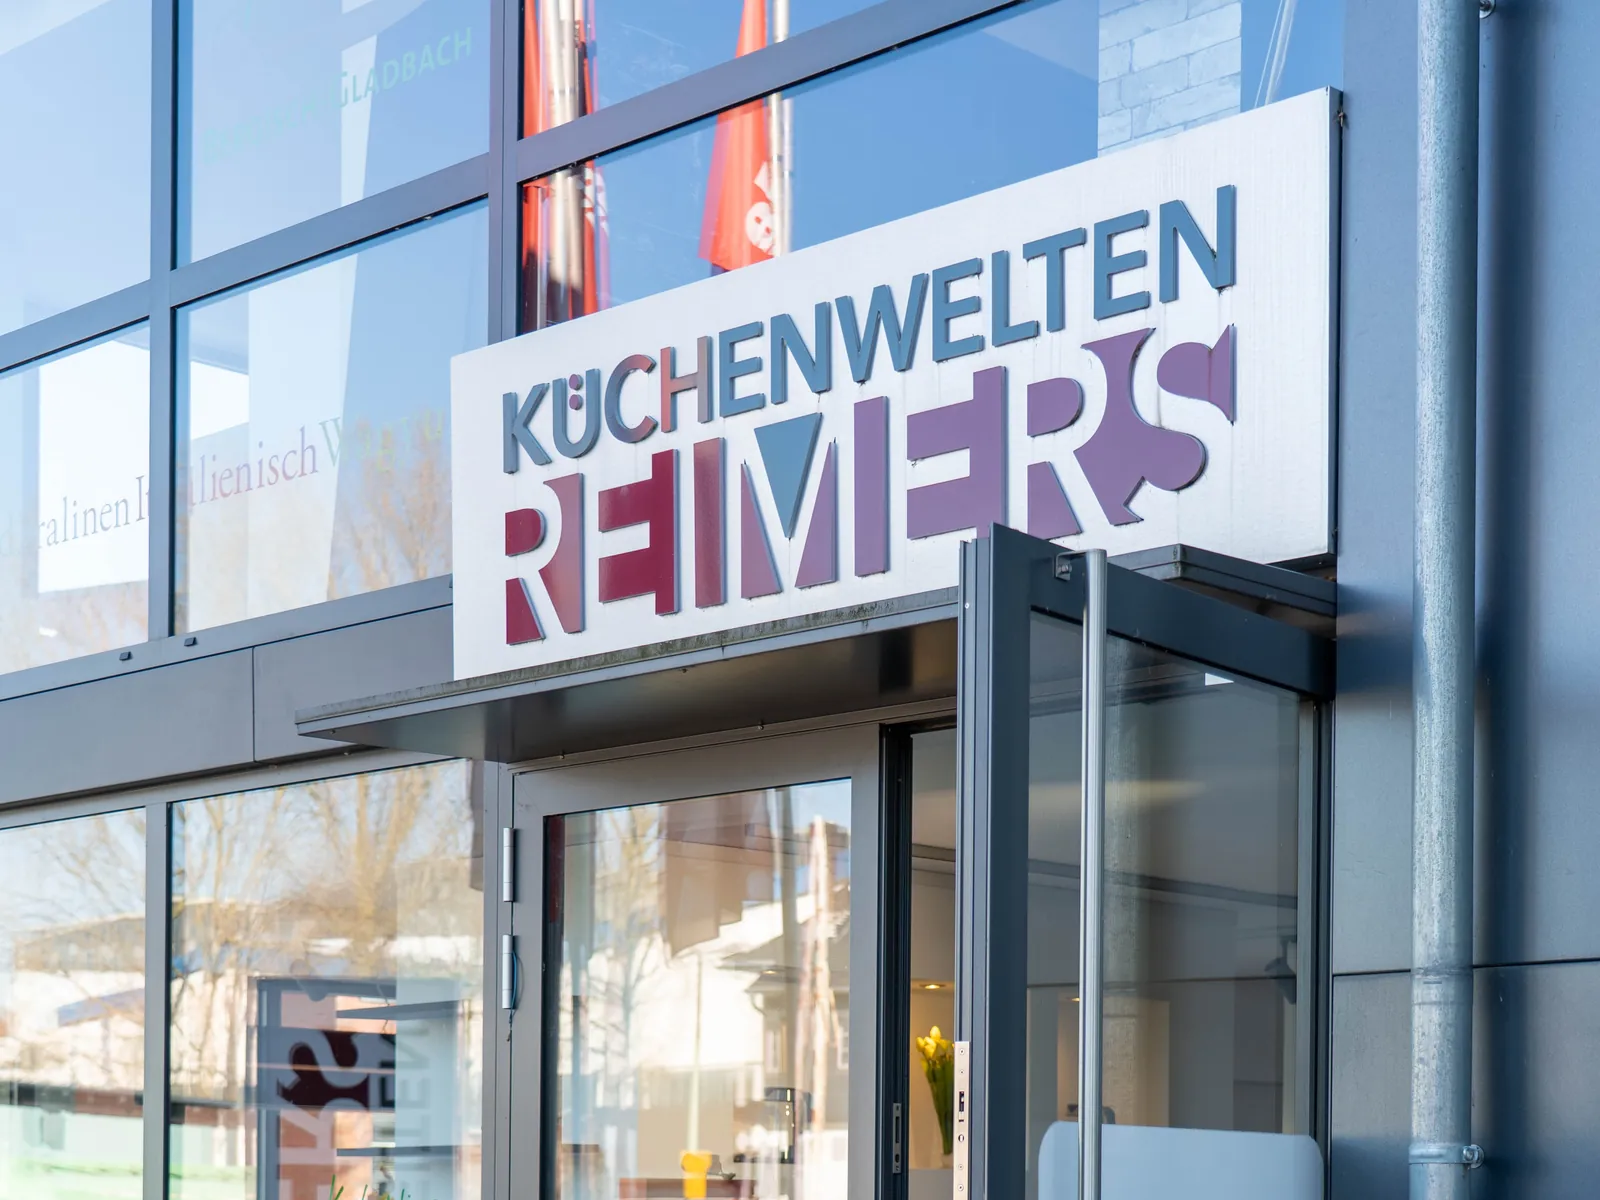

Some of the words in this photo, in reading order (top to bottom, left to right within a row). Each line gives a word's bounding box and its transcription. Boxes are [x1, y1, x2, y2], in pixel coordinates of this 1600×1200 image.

[329, 26, 473, 109] GLADBACH
[503, 184, 1237, 475] KÜCHENWELTEN
[505, 324, 1237, 647] REIMERS
